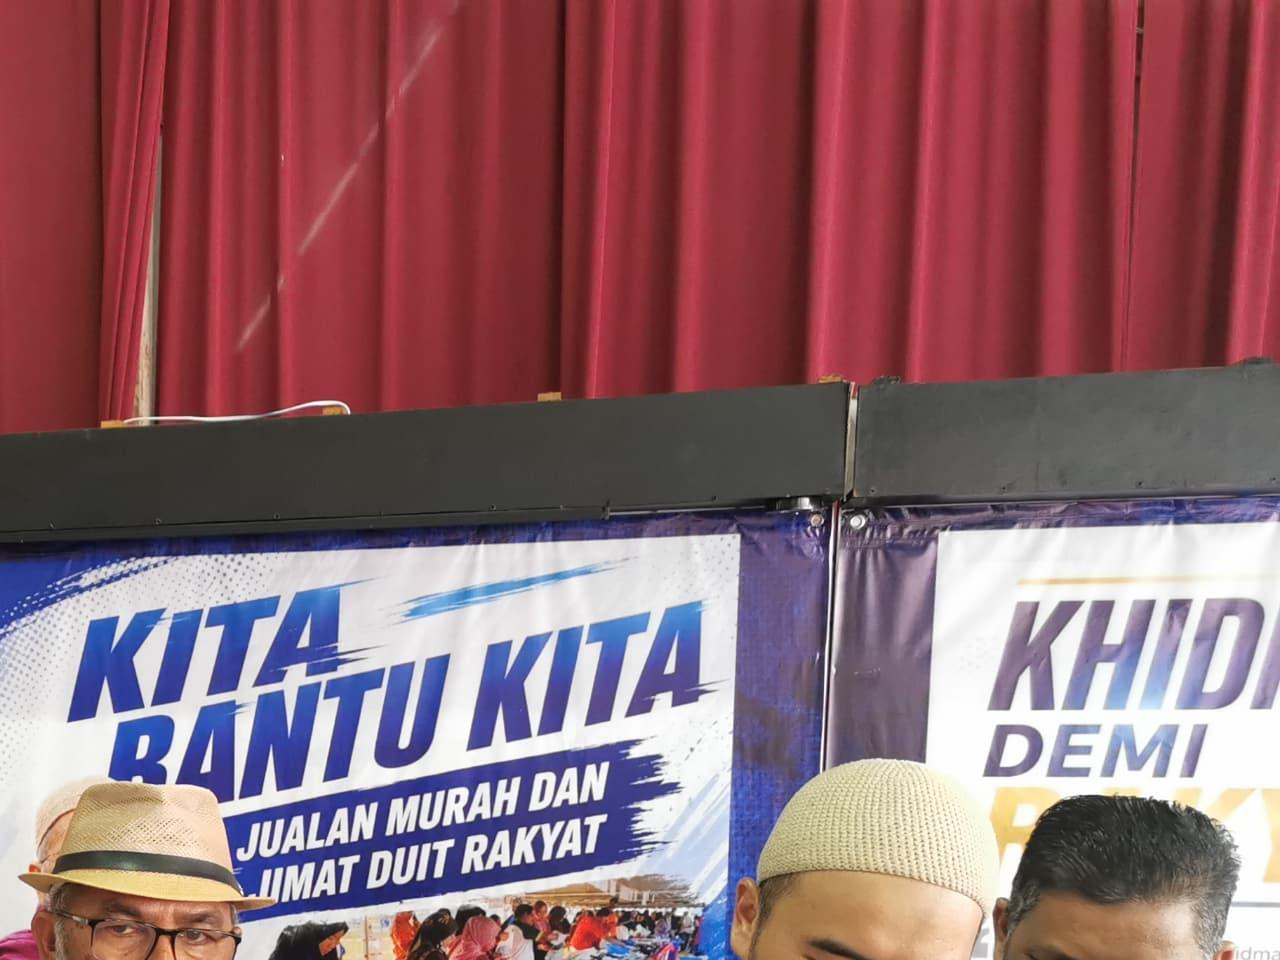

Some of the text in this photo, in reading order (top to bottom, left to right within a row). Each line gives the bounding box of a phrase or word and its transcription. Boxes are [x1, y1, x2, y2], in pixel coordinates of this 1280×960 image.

[68, 586, 342, 722] KITA
[107, 600, 708, 805] BANTU KITA
[983, 724, 1208, 778] DEMI
[236, 761, 610, 862] JUALAN MURAH DAN
[366, 839, 454, 890] DUIT
[461, 814, 608, 874] RAKYAT
